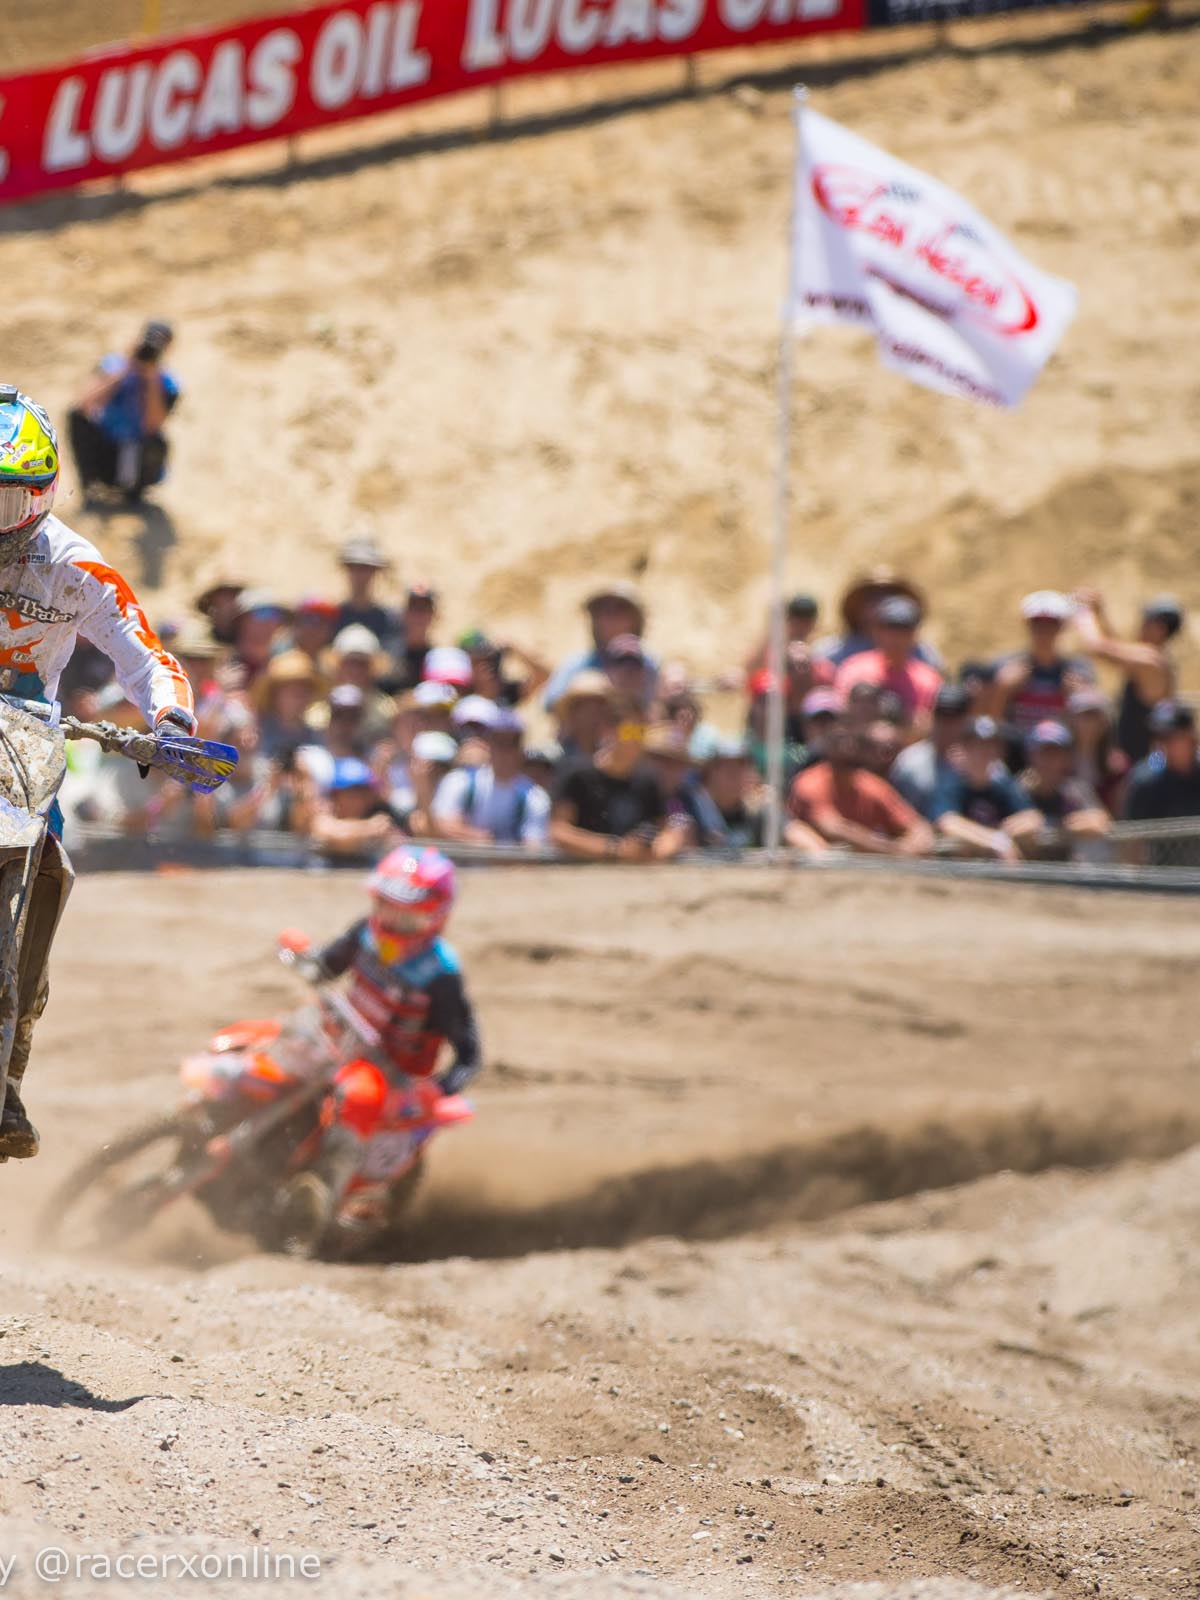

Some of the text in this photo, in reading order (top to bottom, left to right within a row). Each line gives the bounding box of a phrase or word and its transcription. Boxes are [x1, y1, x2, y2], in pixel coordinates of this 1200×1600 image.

[45, 1, 431, 169] LUCAS OIL
[18, 596, 74, 624] Trader
